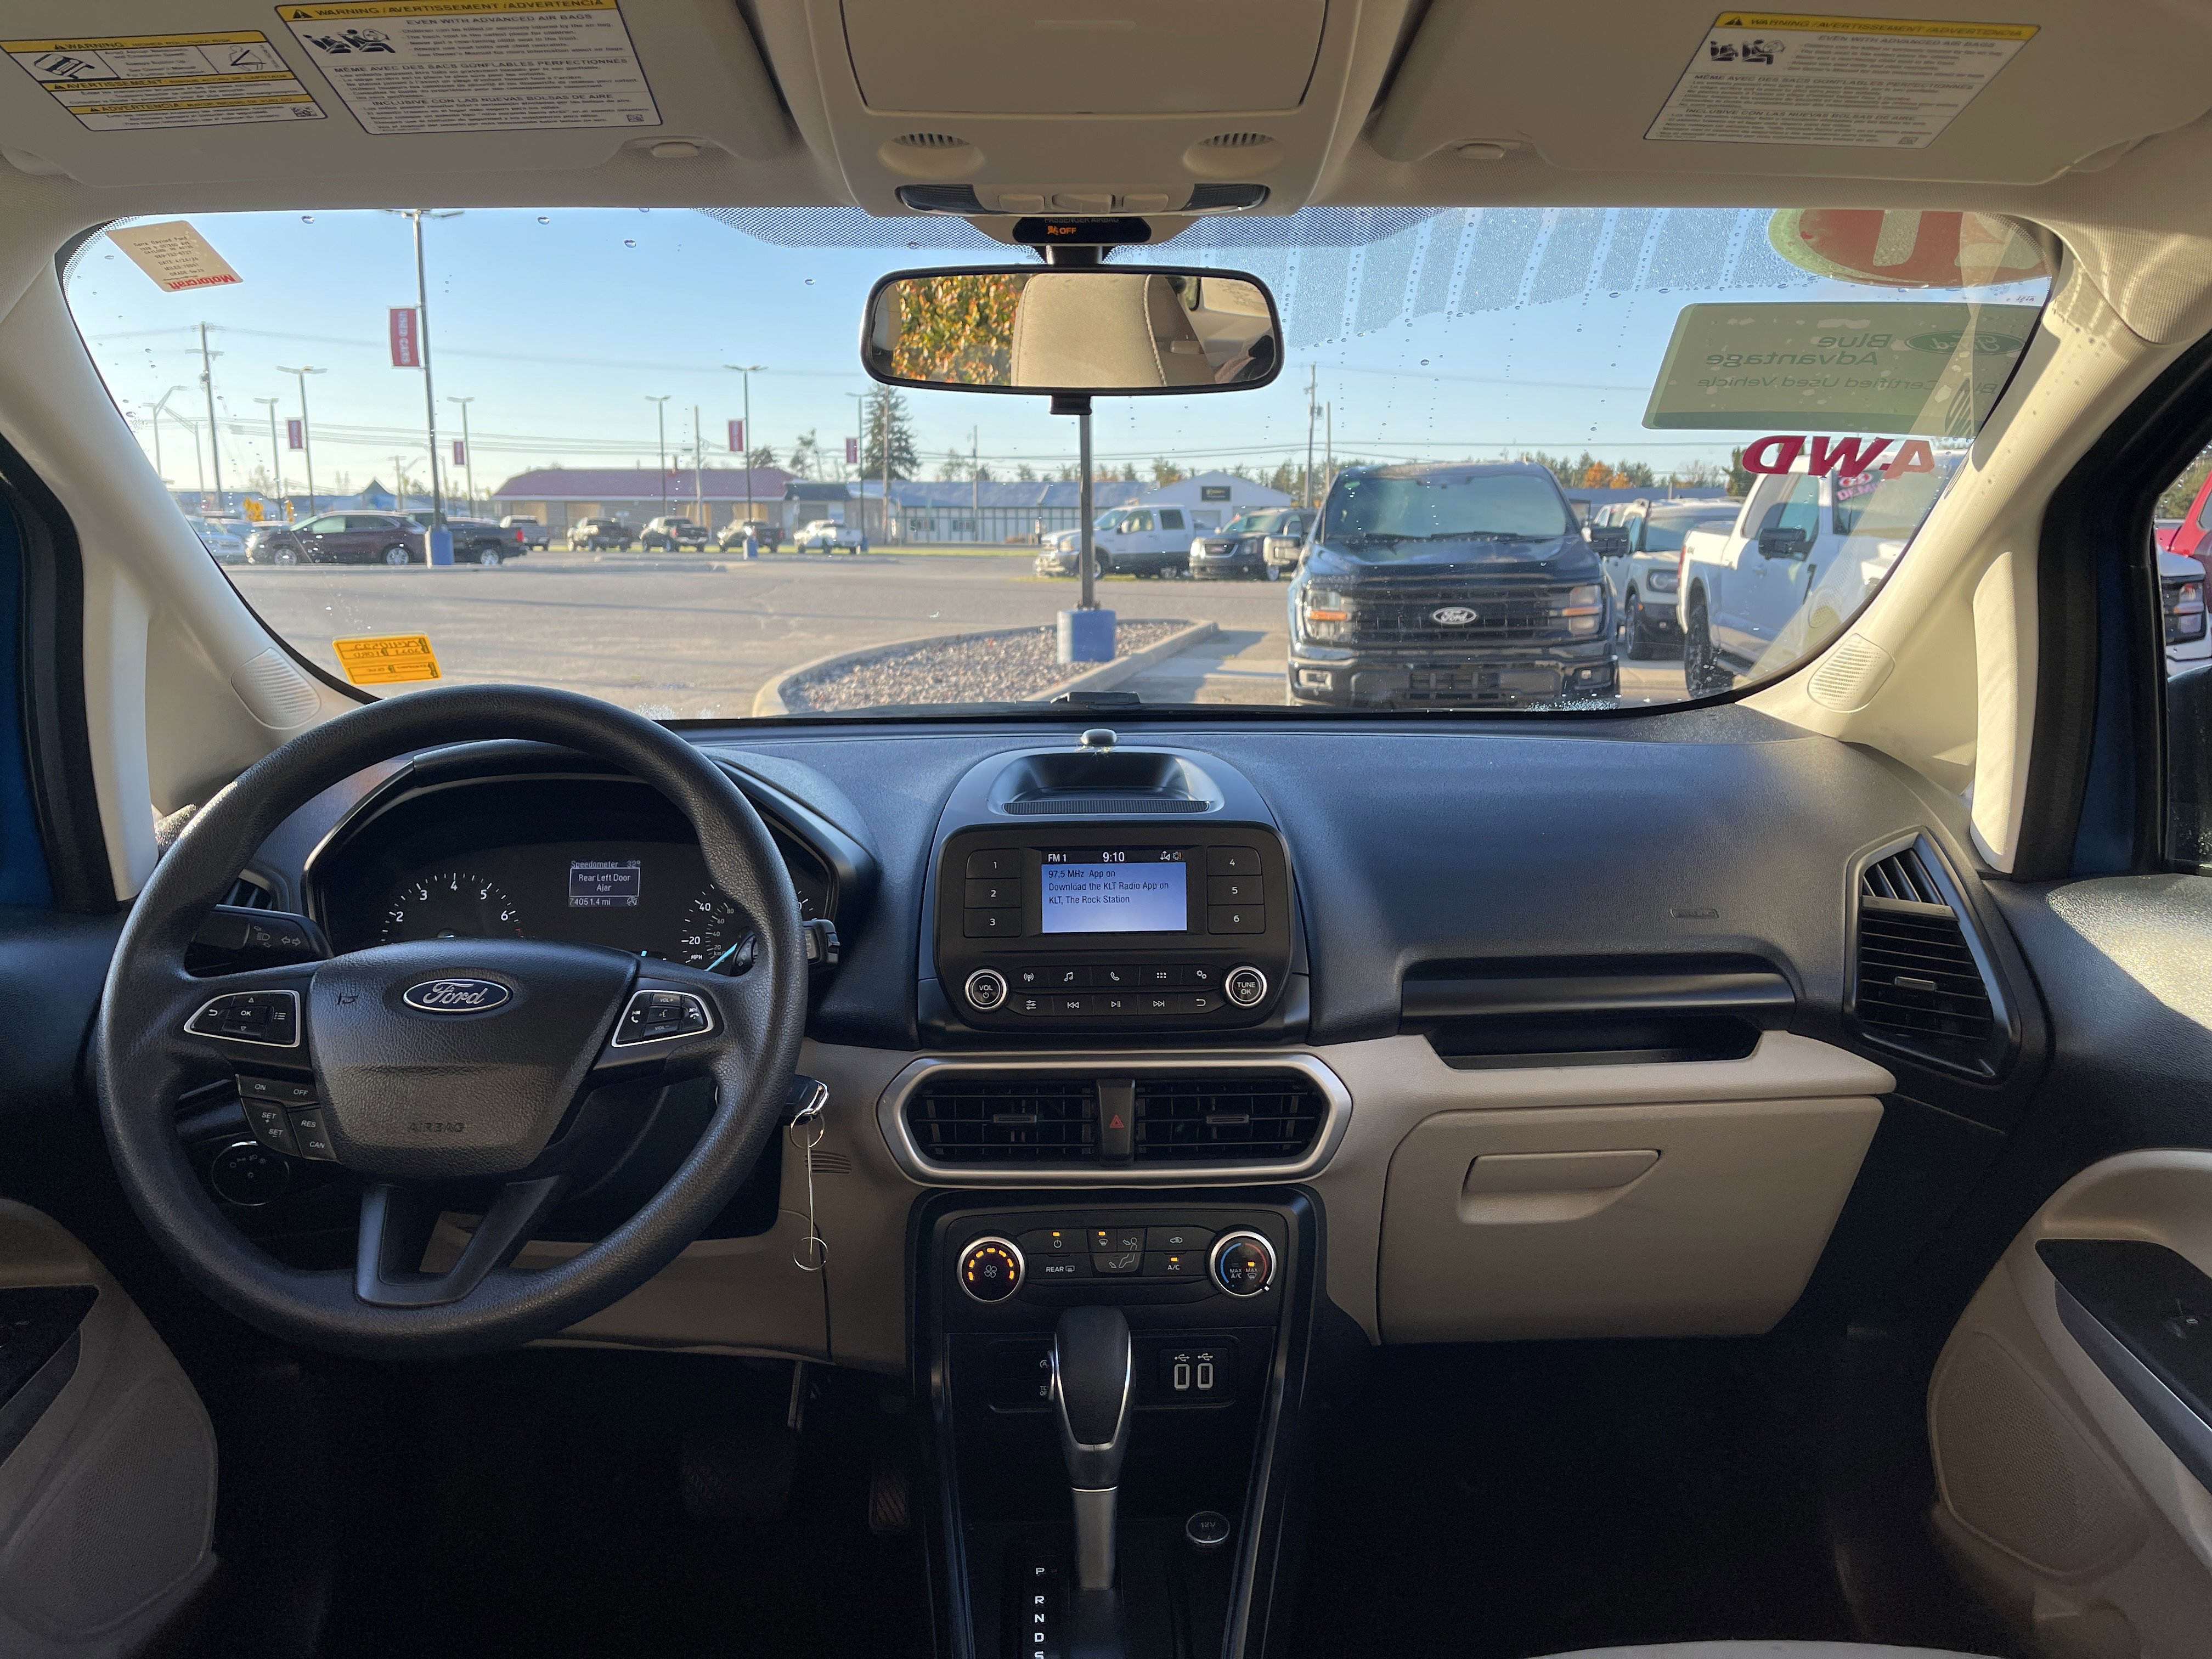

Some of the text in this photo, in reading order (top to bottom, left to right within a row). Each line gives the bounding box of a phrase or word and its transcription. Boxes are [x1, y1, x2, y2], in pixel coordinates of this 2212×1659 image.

[317, 7, 380, 16] WARNING
[1752, 19, 1809, 27] WARNING
[1880, 37, 1940, 46] ADVANCED
[67, 80, 163, 88] AVERTISSEMENT
[102, 103, 180, 112] ADVERTENCIA
[167, 274, 236, 290] Motorcraft
[1439, 610, 1469, 622] Ford
[1102, 851, 1125, 862] 9:10
[1229, 858, 1235, 866] 4
[613, 873, 631, 882] Door
[1048, 870, 1065, 878] 97.5
[1067, 870, 1085, 878] MHz
[1089, 870, 1103, 879] App
[450, 880, 458, 891] 4
[596, 884, 612, 893] Ajar
[1048, 883, 1086, 891] Download
[1142, 882, 1157, 890] App
[1232, 886, 1238, 894] 5
[420, 889, 427, 901] 3
[480, 889, 487, 900] 5
[990, 889, 997, 898] 2
[1049, 896, 1063, 905] KLT,
[1082, 895, 1101, 904] Rock
[699, 902, 711, 911] 40
[396, 911, 404, 922] 2
[500, 910, 509, 921] 6
[989, 918, 996, 926] 3
[689, 936, 701, 945] 20
[422, 982, 488, 1006] Ford
[301, 1120, 317, 1128] RES
[409, 1122, 465, 1132] AIRBAG
[268, 1128, 284, 1136] SET
[1035, 1595, 1045, 1605] R
[1034, 1613, 1045, 1623] N
[1034, 1633, 1045, 1643] D
[1034, 1651, 1044, 1659] S
